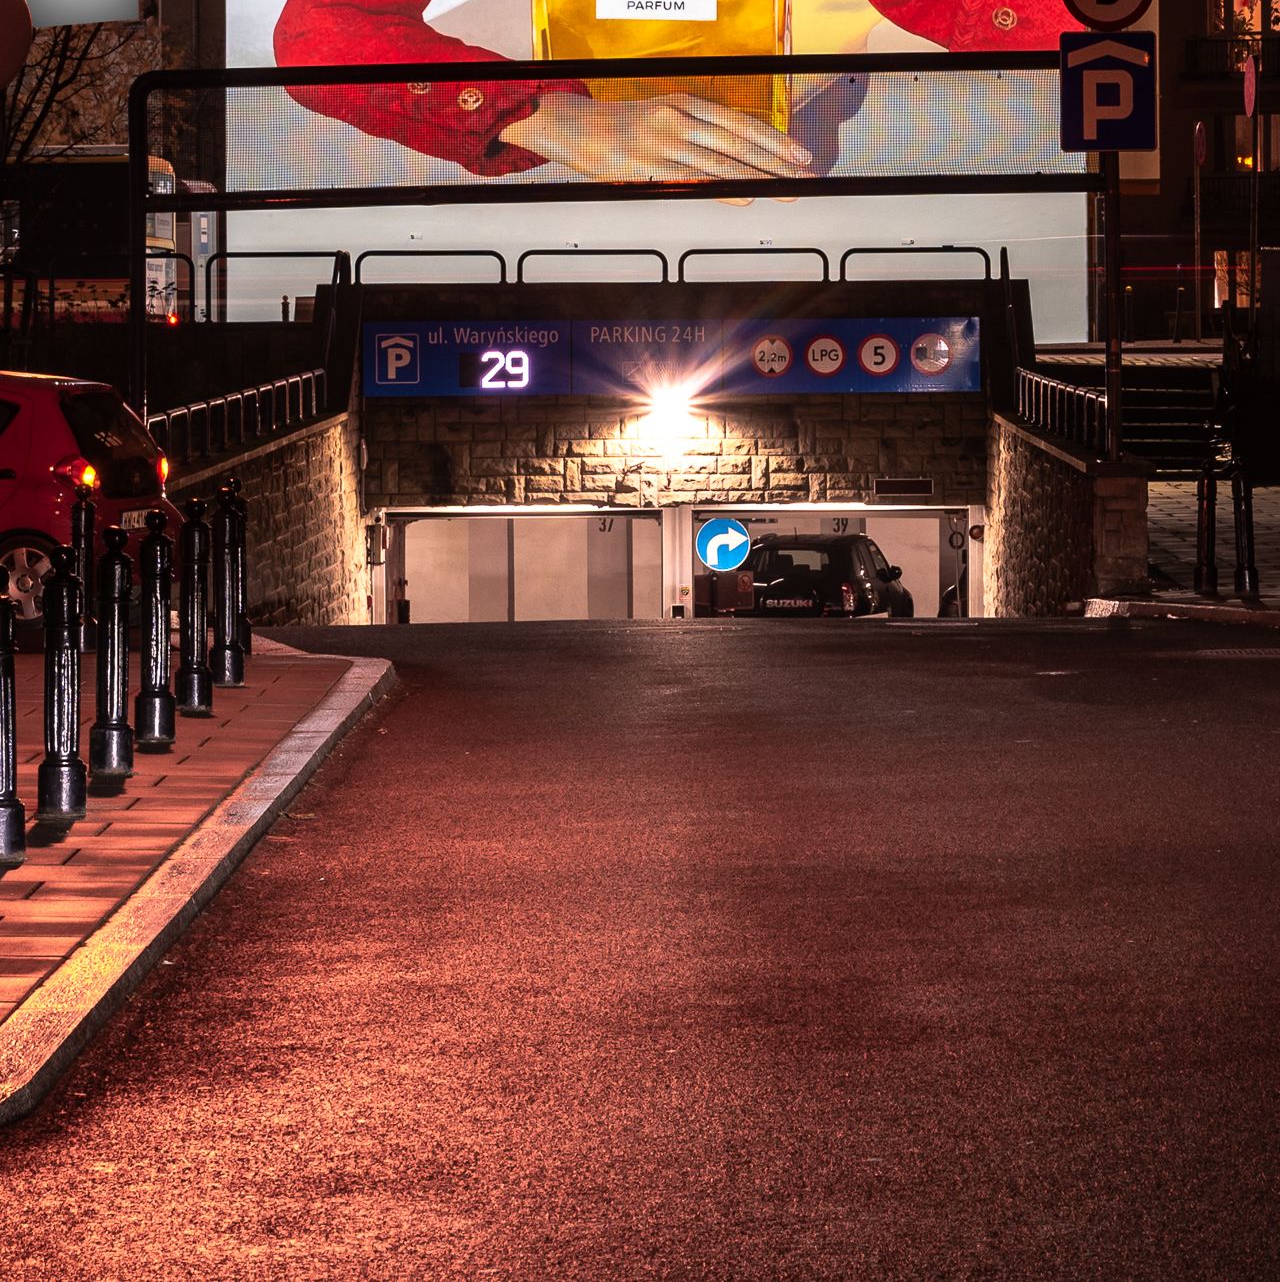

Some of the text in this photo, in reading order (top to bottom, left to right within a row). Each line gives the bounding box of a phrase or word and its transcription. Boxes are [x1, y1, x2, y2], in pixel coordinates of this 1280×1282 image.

[627, 1, 685, 11] PARFUM
[1082, 68, 1134, 141] P
[427, 325, 560, 348] ul. Waryńskiego
[590, 326, 705, 344] PARKING 24H
[812, 349, 839, 362] LPG
[873, 345, 886, 366] 5
[480, 350, 530, 389] 29
[832, 517, 848, 532] 39
[765, 598, 813, 609] SUZUKI
